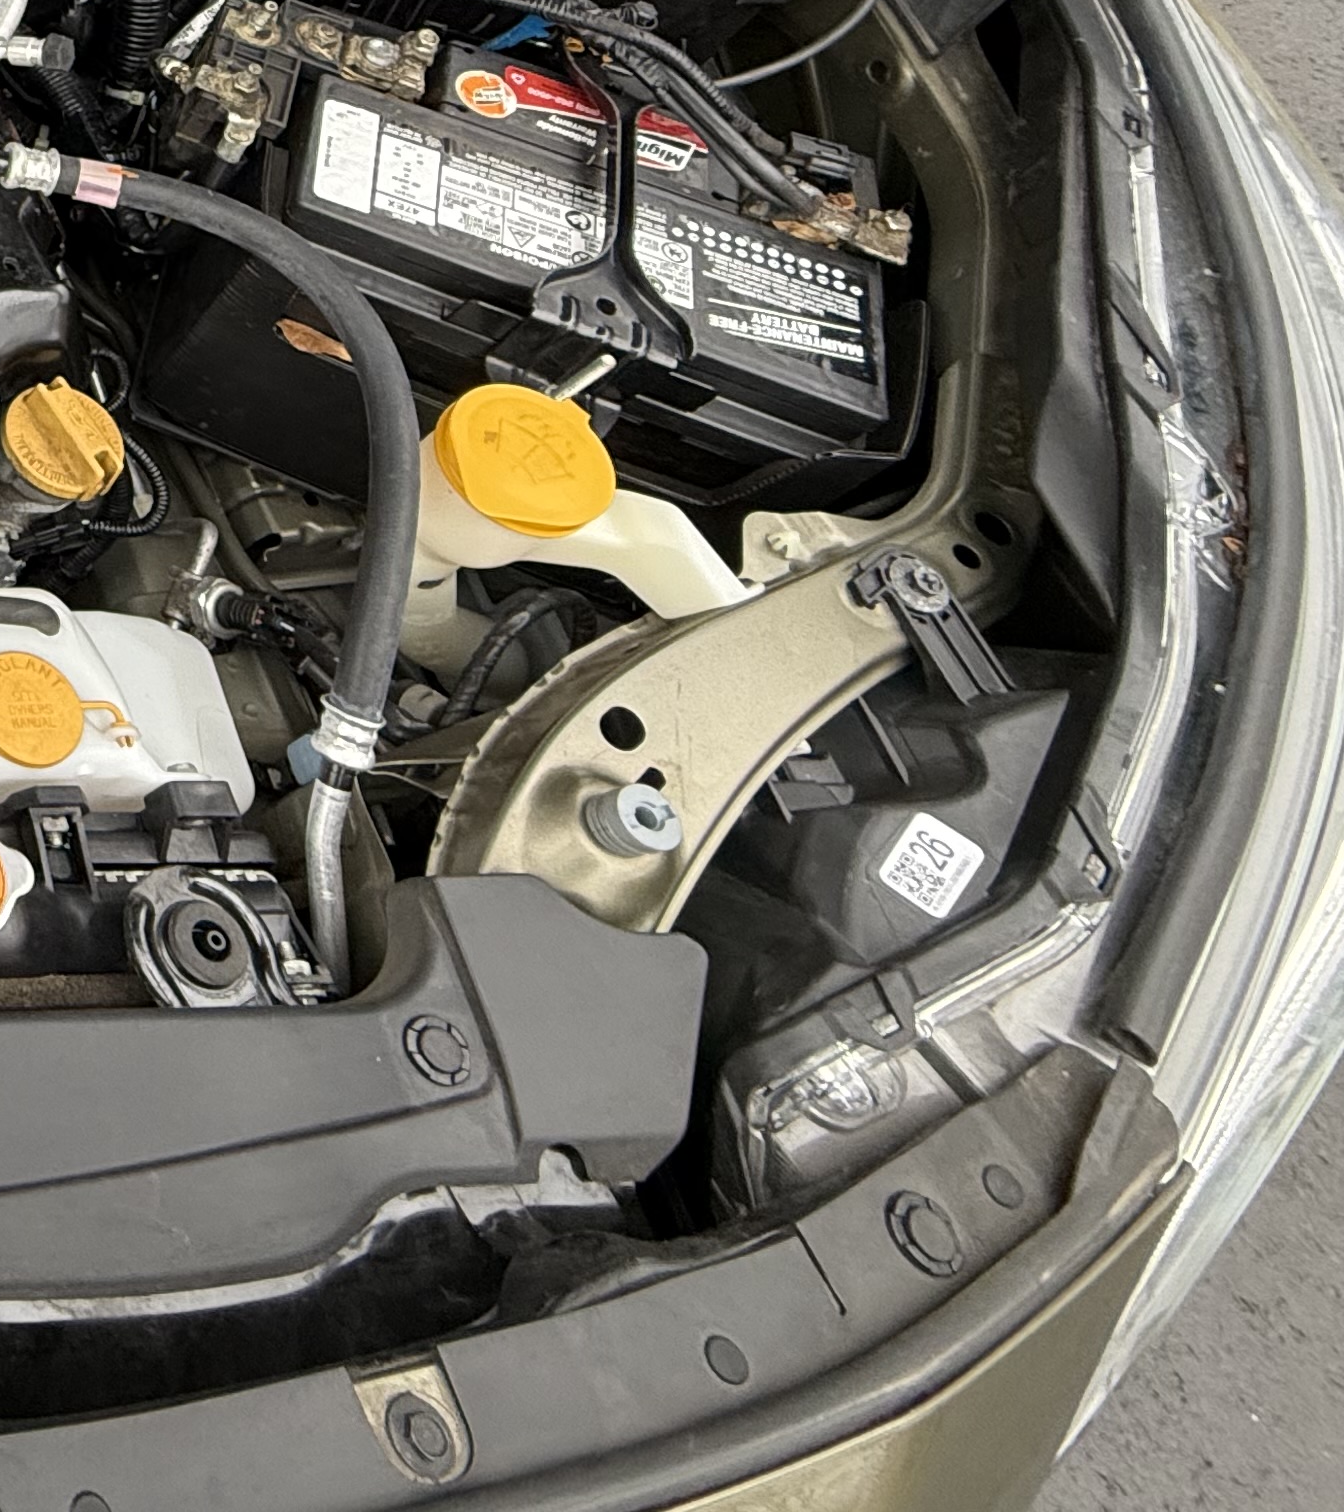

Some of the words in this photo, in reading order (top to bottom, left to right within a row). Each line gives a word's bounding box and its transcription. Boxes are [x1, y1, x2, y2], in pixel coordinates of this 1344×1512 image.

[536, 119, 596, 147] Nationwide
[548, 114, 596, 138] Warranty
[708, 314, 864, 357] MAINTENANCE-FREE
[751, 312, 820, 336] BATTERY
[910, 830, 956, 872] 26
